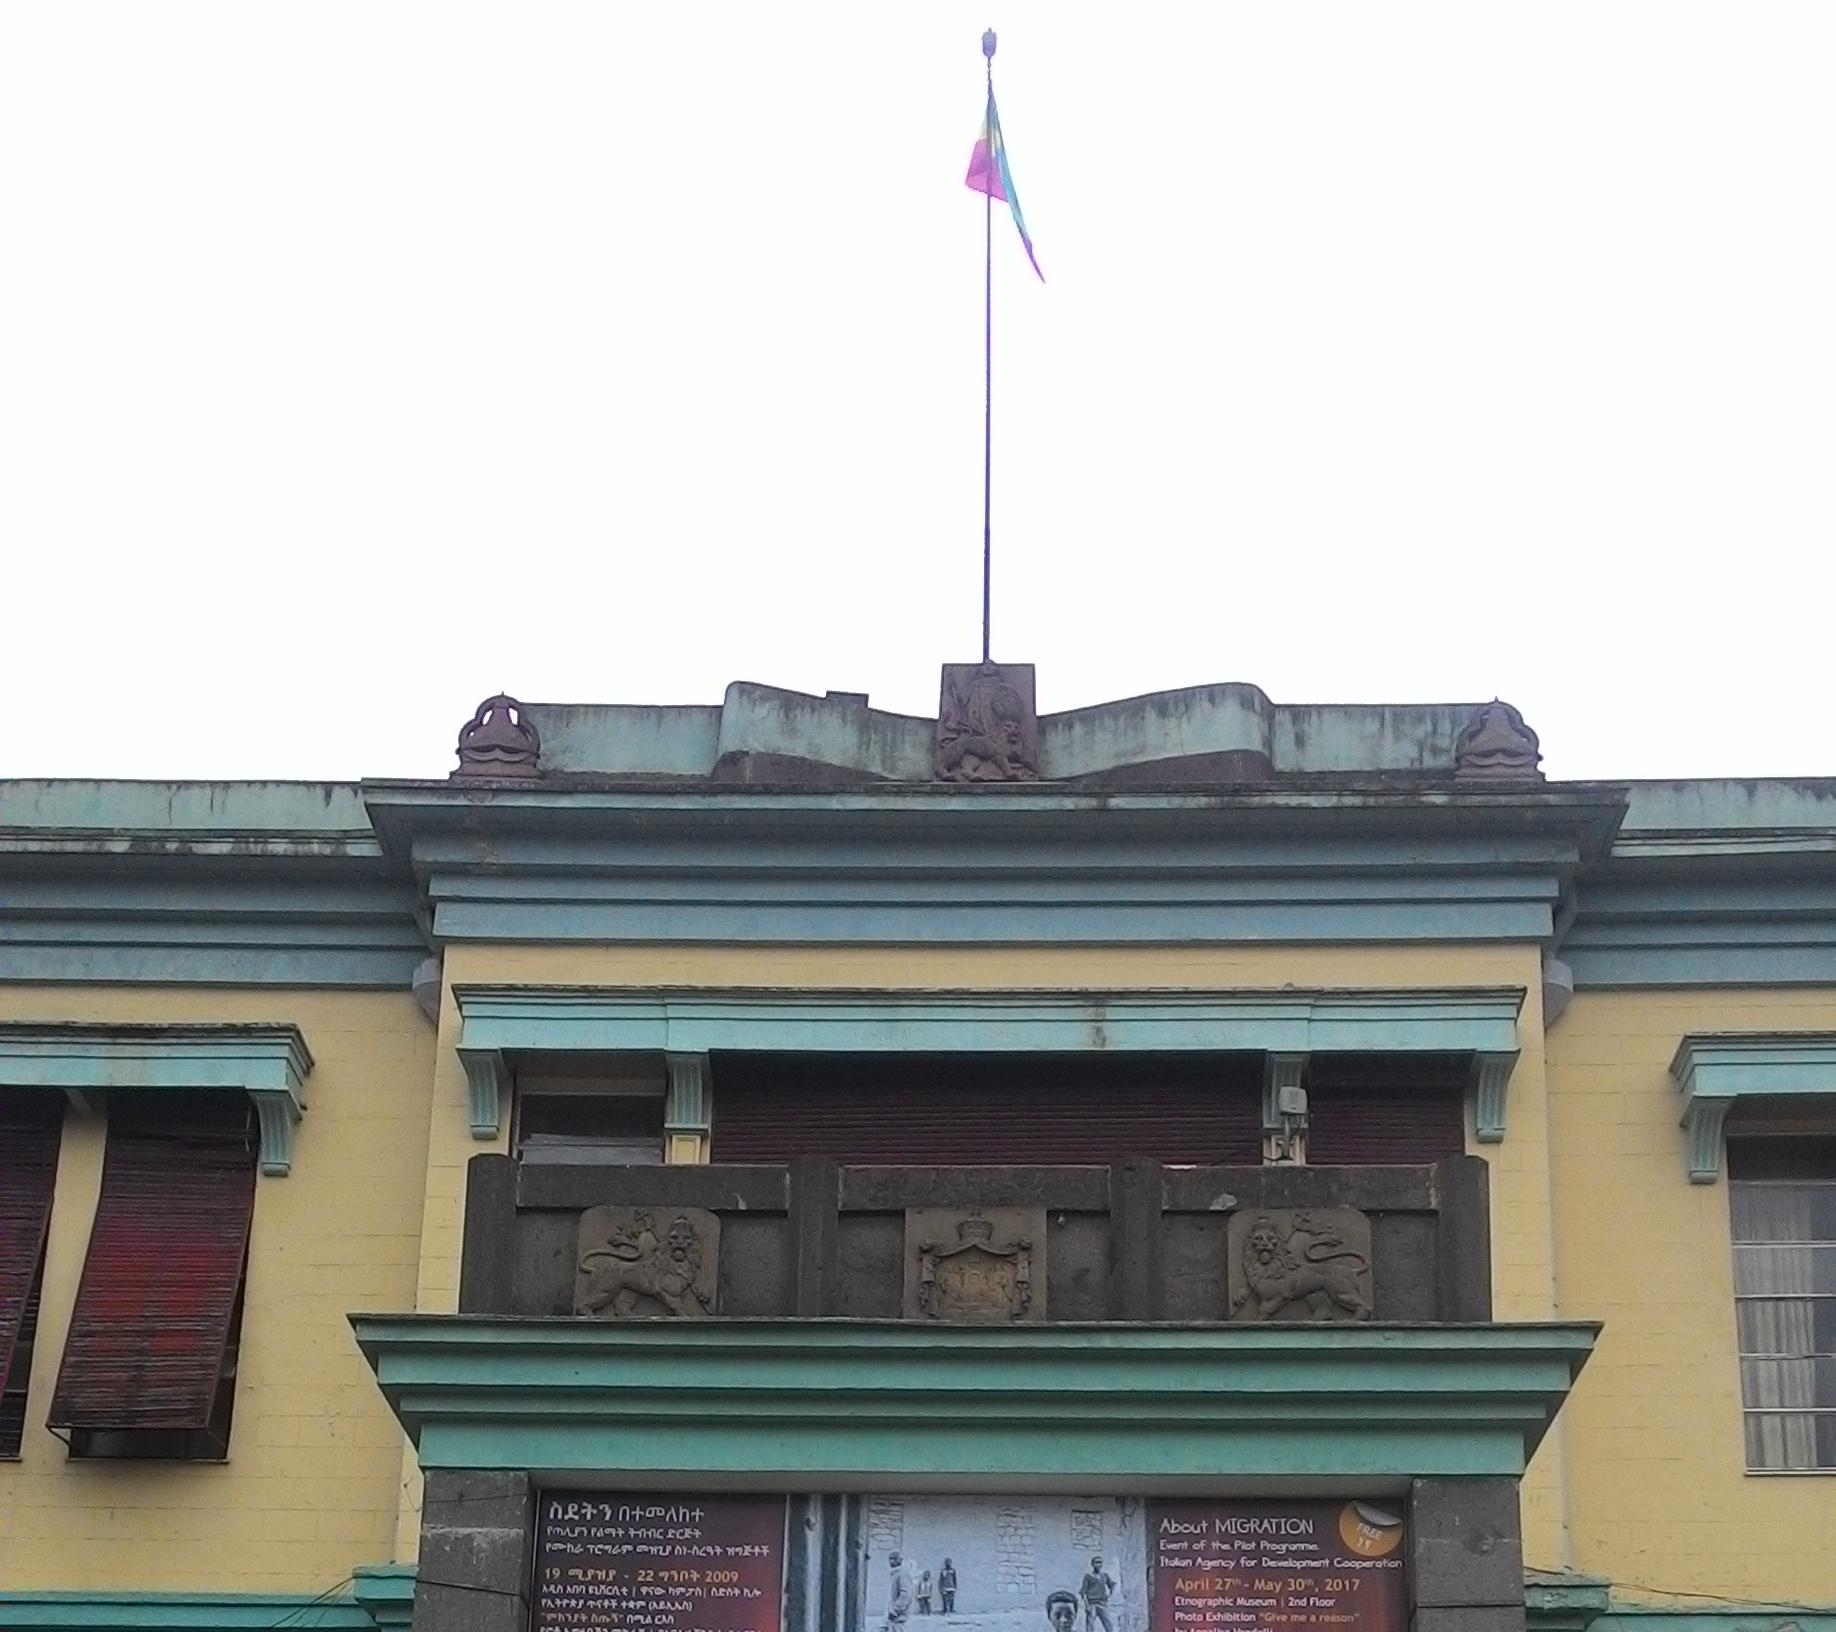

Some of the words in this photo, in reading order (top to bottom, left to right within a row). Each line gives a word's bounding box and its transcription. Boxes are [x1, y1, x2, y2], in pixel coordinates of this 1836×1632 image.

[549, 1501, 612, 1521] ስደትን
[618, 1504, 705, 1523] በተመለከተ
[1160, 1518, 1208, 1534] About
[1215, 1518, 1314, 1535] MIGRATION
[1356, 1521, 1384, 1540] FREE
[1160, 1540, 1188, 1550] Event
[1192, 1540, 1206, 1550] of
[1212, 1541, 1232, 1551] the
[1234, 1540, 1257, 1550] Pilot
[1160, 1556, 1193, 1567] Italian
[1195, 1557, 1235, 1570] Agency
[1240, 1556, 1257, 1567] for
[1262, 1557, 1330, 1569] Development
[1333, 1557, 1403, 1569] Cooperation
[545, 1568, 560, 1579] 19
[637, 1570, 654, 1581] 22
[705, 1571, 739, 1583] 2009
[1174, 1578, 1209, 1593] April
[1253, 1578, 1282, 1593] May
[1325, 1579, 1360, 1591] 2017
[1174, 1596, 1234, 1608] Etnographic
[1236, 1597, 1277, 1606] Museum
[1288, 1597, 1307, 1607] 2nd
[1310, 1597, 1336, 1607] Floor
[1174, 1611, 1203, 1622] Photo
[1206, 1611, 1256, 1622] Exhibition
[1290, 1614, 1308, 1622] me
[1309, 1614, 1317, 1622] a
